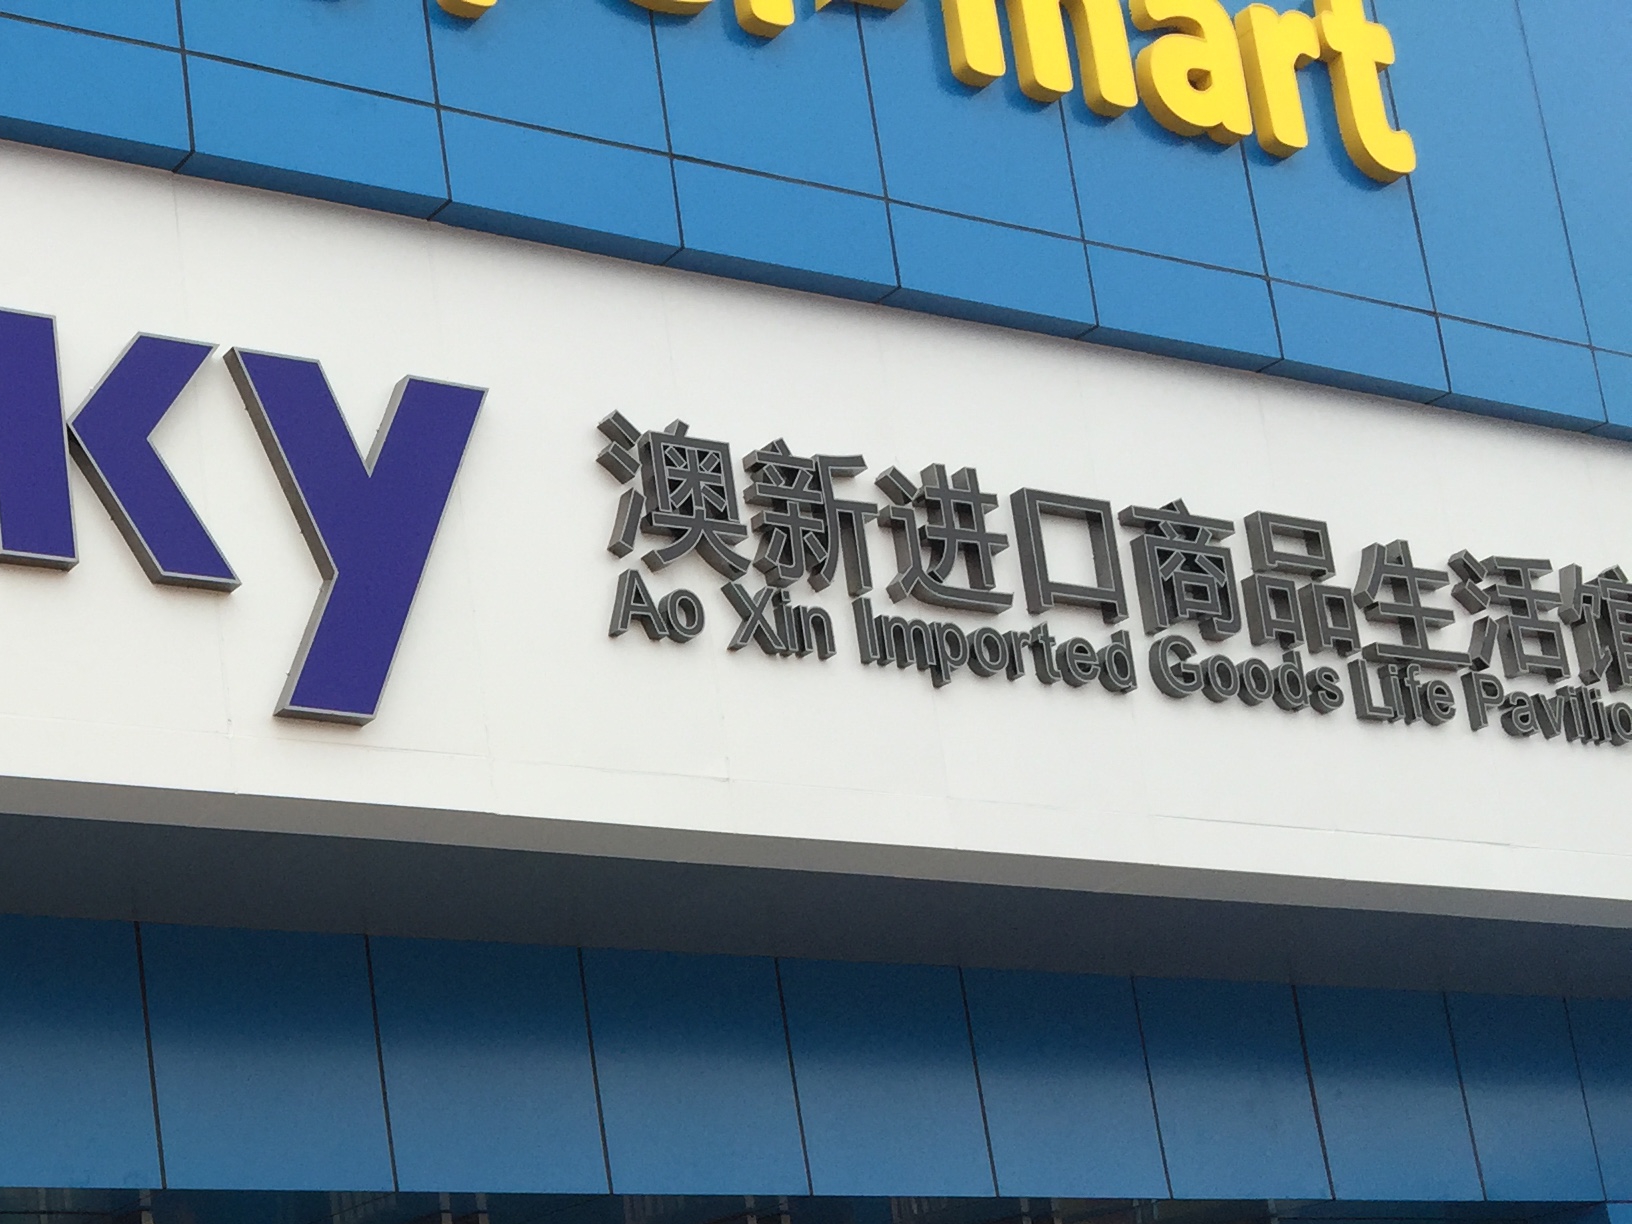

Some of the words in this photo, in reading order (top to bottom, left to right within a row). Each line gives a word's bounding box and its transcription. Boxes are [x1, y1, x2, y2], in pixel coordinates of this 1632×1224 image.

[597, 410, 1632, 692] 澳新进口商品生活馆
[608, 568, 706, 644] Ao
[721, 581, 838, 660] Xin
[853, 597, 1138, 694] Imported
[1148, 634, 1345, 715] Goods
[1347, 658, 1456, 727] Life
